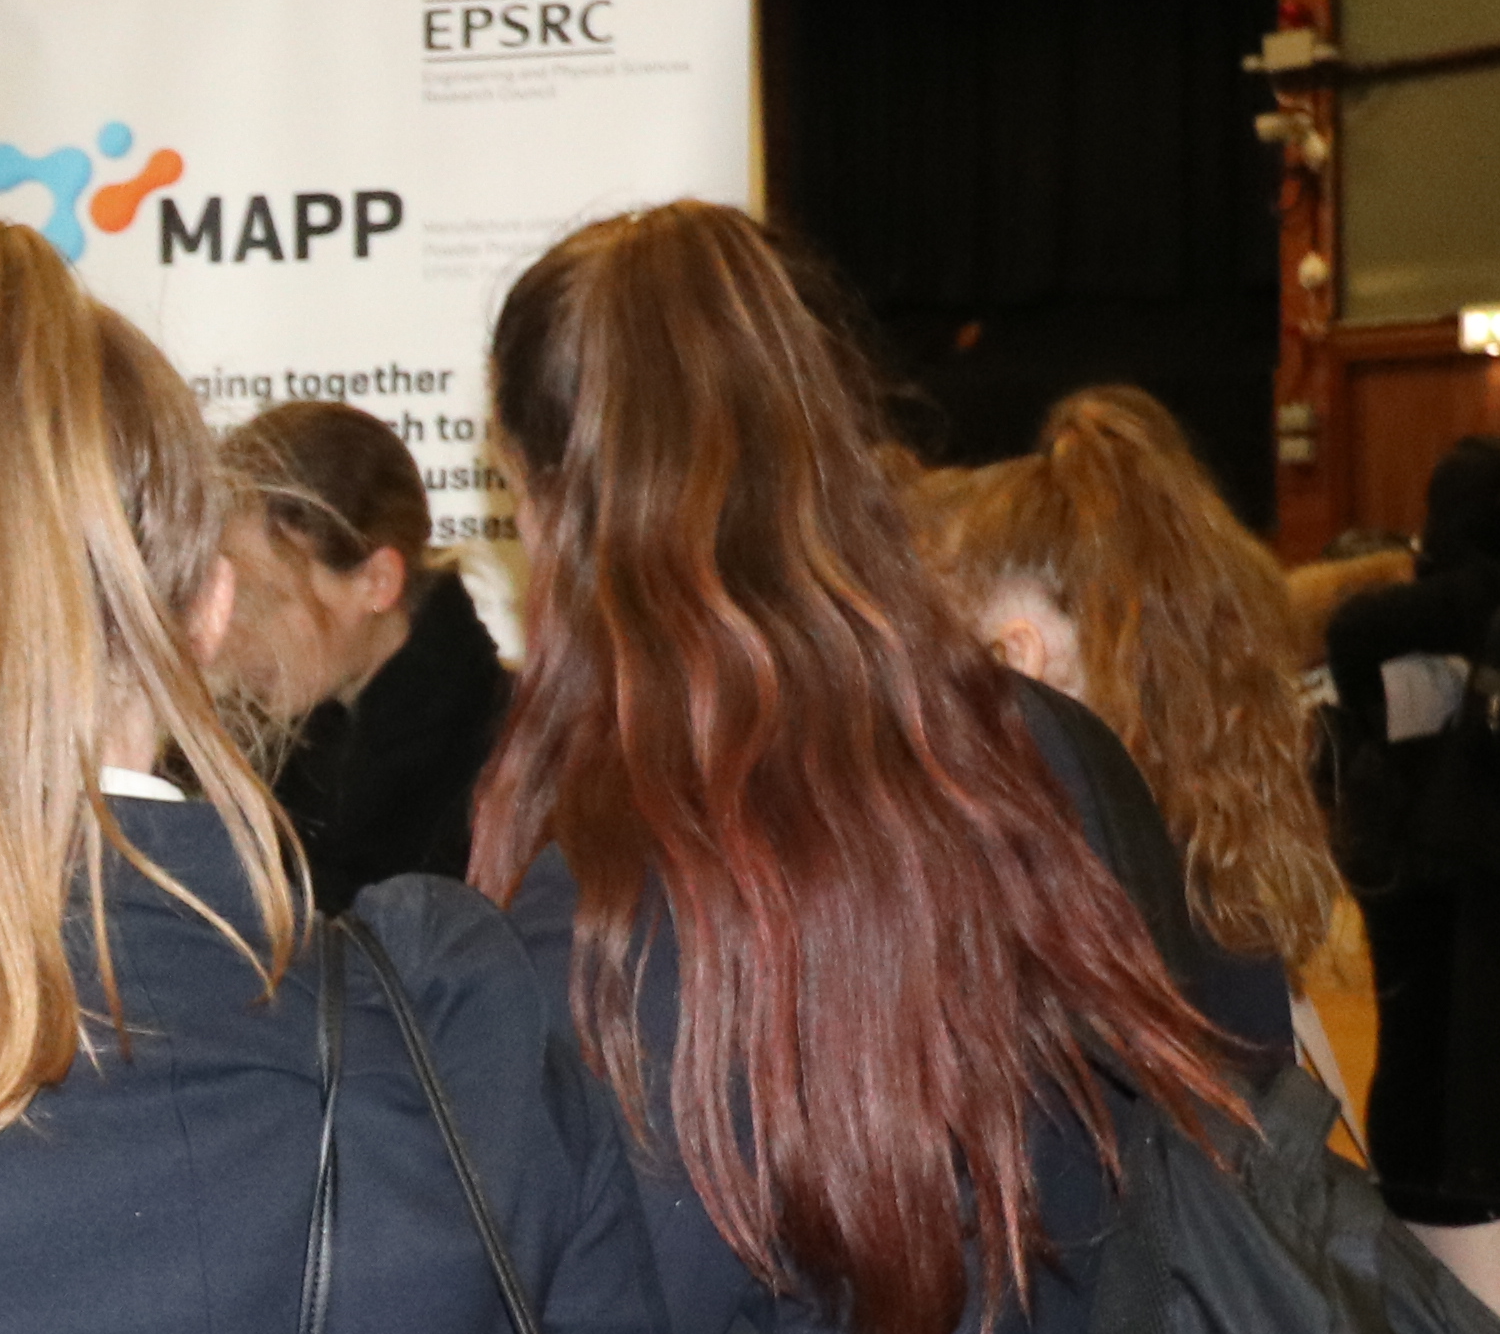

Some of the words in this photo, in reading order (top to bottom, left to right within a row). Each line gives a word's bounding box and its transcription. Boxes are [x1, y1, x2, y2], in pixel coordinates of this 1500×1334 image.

[423, 0, 613, 51] EPSRC
[159, 191, 404, 264] MAPP
[188, 368, 272, 400] ging
[285, 364, 454, 402] together
[436, 415, 474, 440] to
[425, 457, 507, 490] usin
